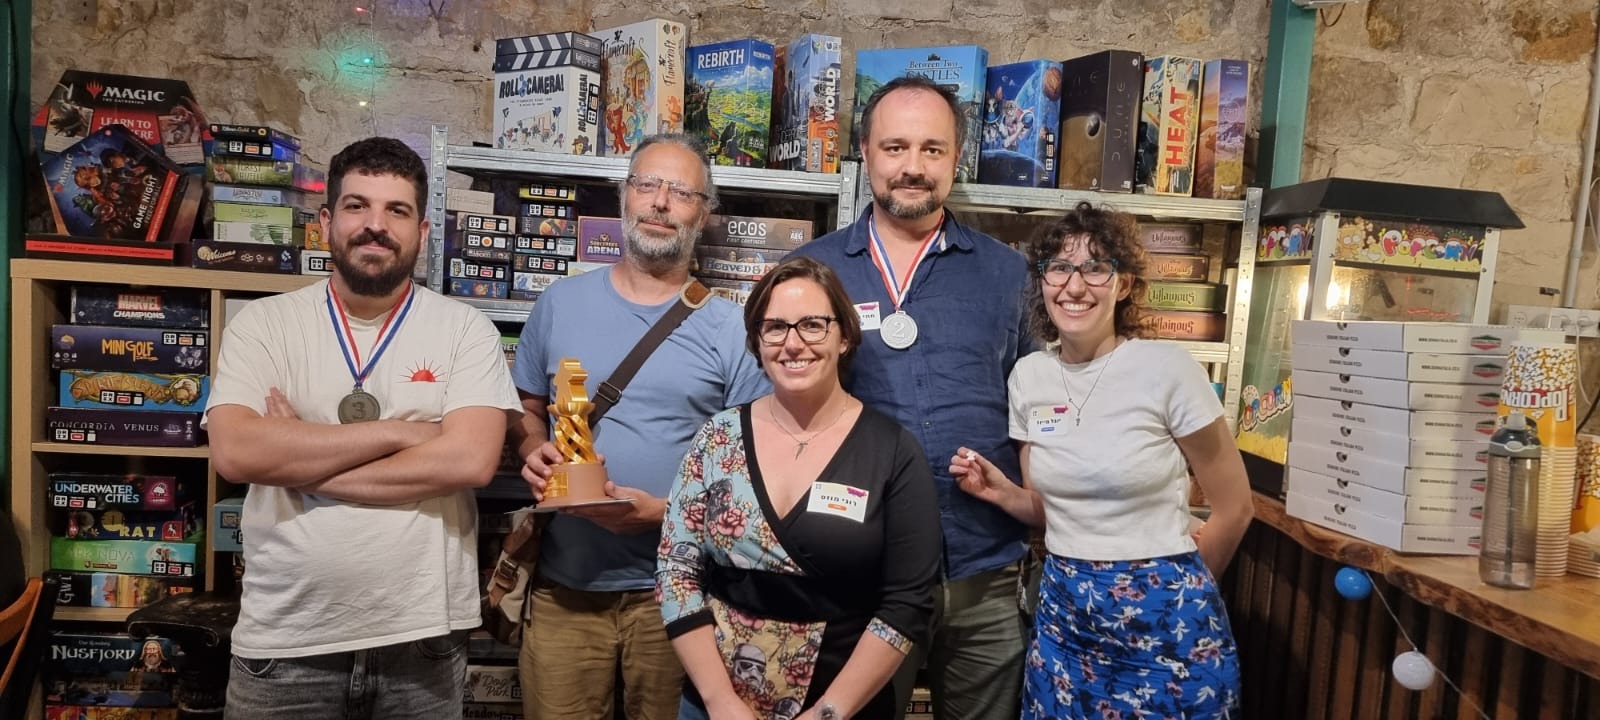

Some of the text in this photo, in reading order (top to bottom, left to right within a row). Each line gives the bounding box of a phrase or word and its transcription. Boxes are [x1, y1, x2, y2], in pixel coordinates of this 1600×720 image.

[663, 39, 678, 87] Flamecraft
[697, 48, 745, 69] REBIRTH
[753, 50, 772, 61] REBIRTH
[944, 59, 958, 67] Two
[906, 70, 960, 80] CASTLES
[499, 73, 564, 98] ROLL CAMERA!
[103, 86, 166, 102] MAGIC
[824, 67, 837, 121] WORLD
[577, 73, 588, 132] ROLL CAMERA!
[101, 117, 151, 129] LEARN TO
[1165, 85, 1186, 165] HEAT
[769, 140, 800, 162] WORLD
[59, 153, 74, 185] MAGIC
[133, 175, 158, 229] GAME NIGHT
[790, 232, 804, 241] AEG
[587, 246, 621, 256] ARENA
[1382, 228, 1479, 262] POPCORN
[113, 310, 165, 319] CHAMPIONS
[892, 321, 905, 338] 2
[351, 401, 366, 419] 3
[1501, 388, 1568, 422] POPCORN
[50, 421, 159, 432] CONCORDIA VENUS
[55, 483, 133, 494] UNDERWATER
[105, 494, 140, 503] CITIES
[119, 526, 156, 537] RAT
[51, 645, 136, 663] NUSFJORD
[482, 675, 508, 688] Dog
[486, 686, 509, 697] Park
